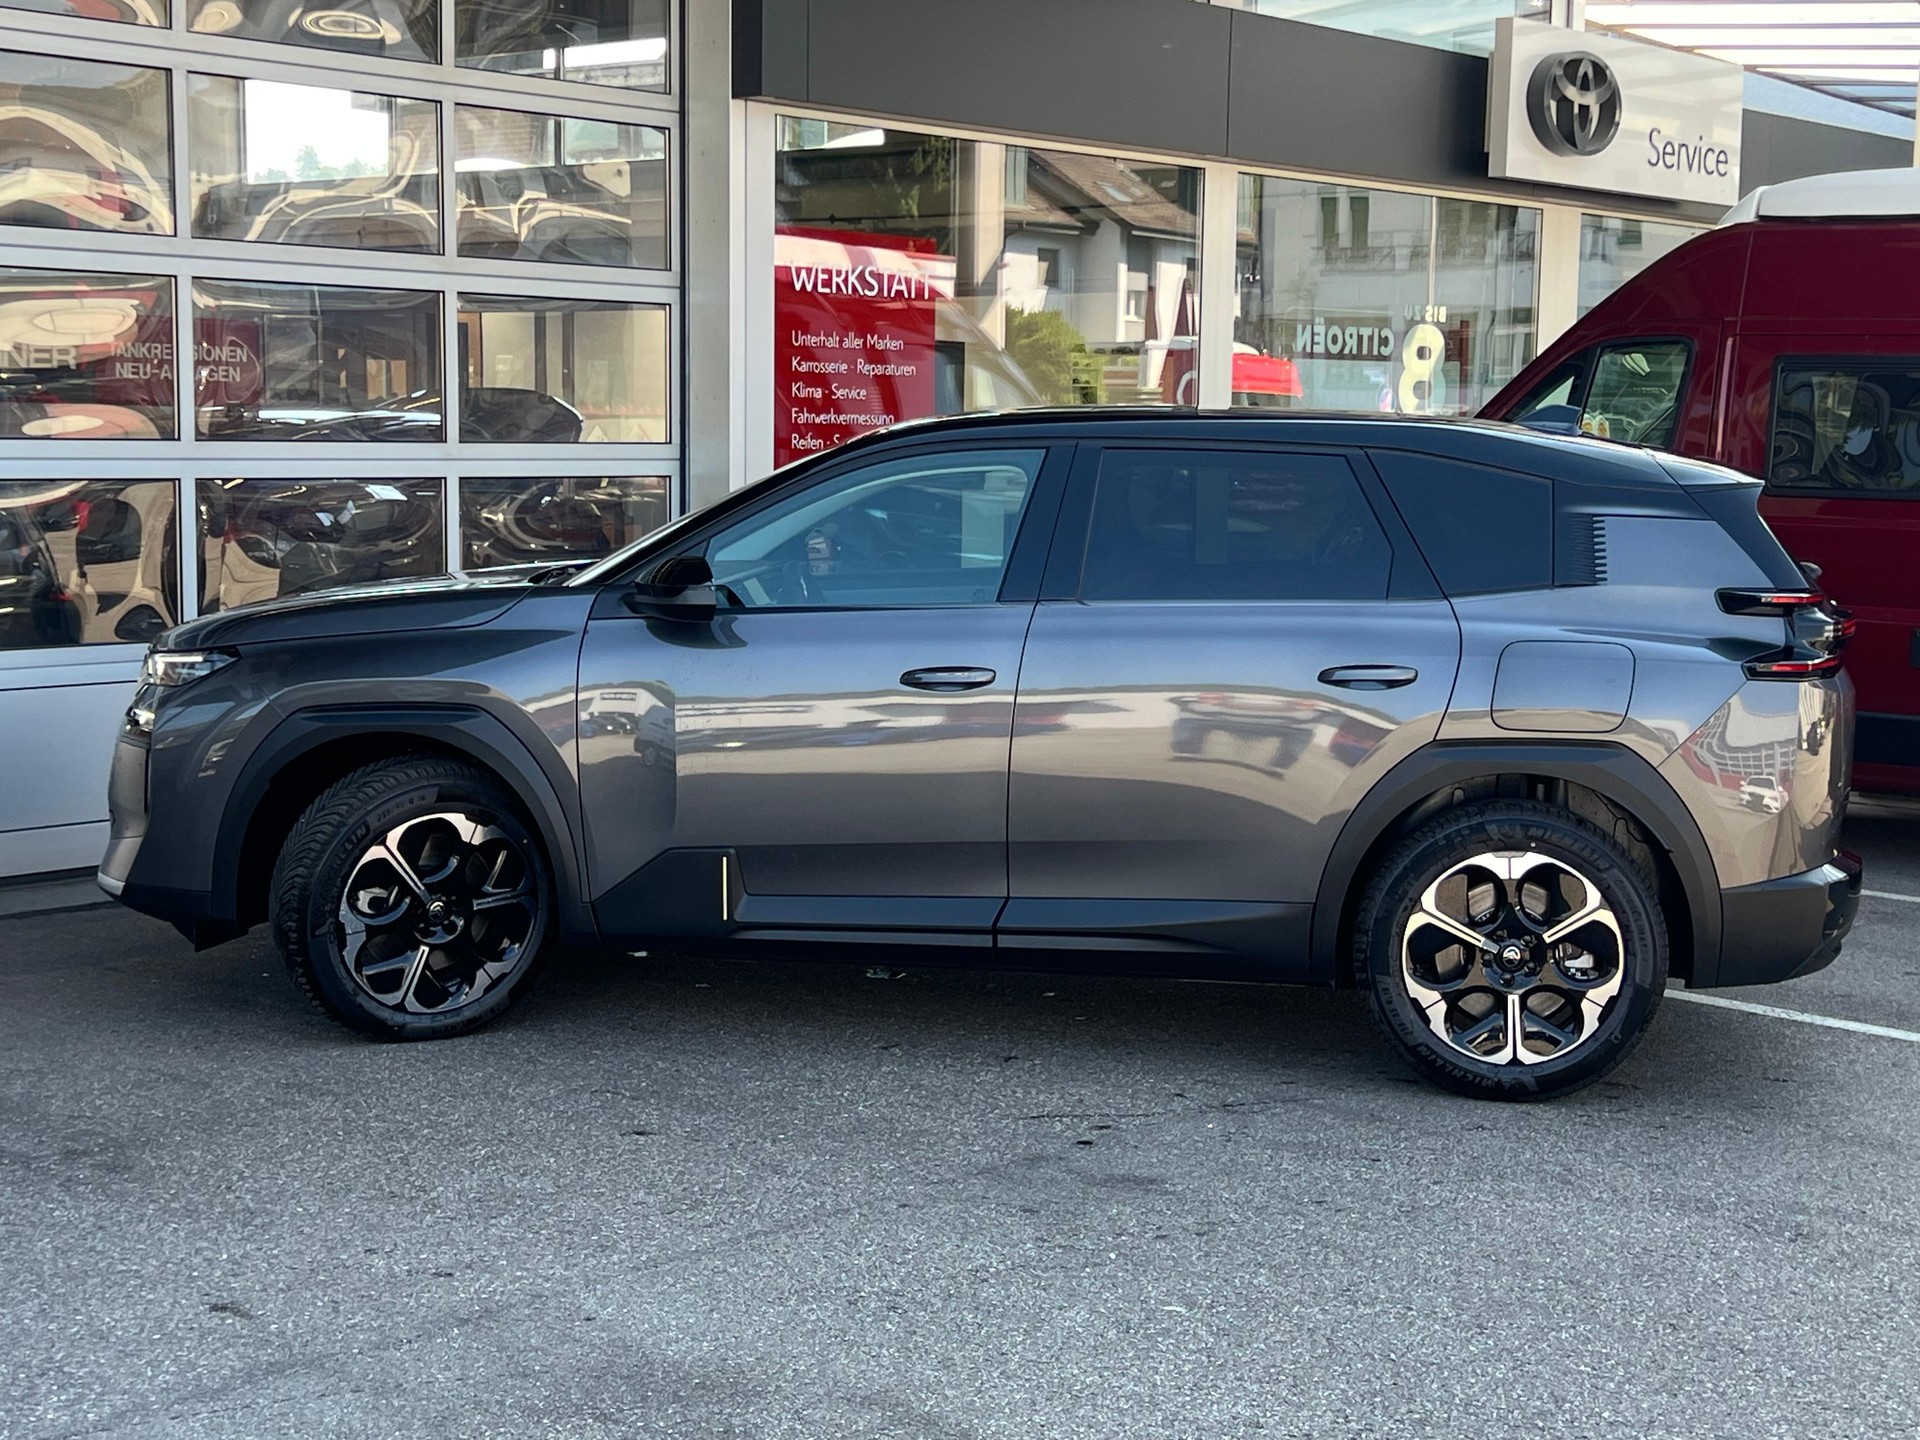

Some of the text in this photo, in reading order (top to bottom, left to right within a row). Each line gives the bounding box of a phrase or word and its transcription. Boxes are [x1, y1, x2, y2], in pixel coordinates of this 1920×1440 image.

[1647, 127, 1729, 177] Service
[790, 263, 932, 300] WERKSTATT
[792, 330, 904, 351] Unterhalt aller Marken
[791, 356, 848, 374] Karrosserie
[856, 358, 917, 379] Reparaturen
[791, 382, 822, 399] Klima
[831, 383, 868, 400] Service
[791, 432, 824, 450] Reifen
